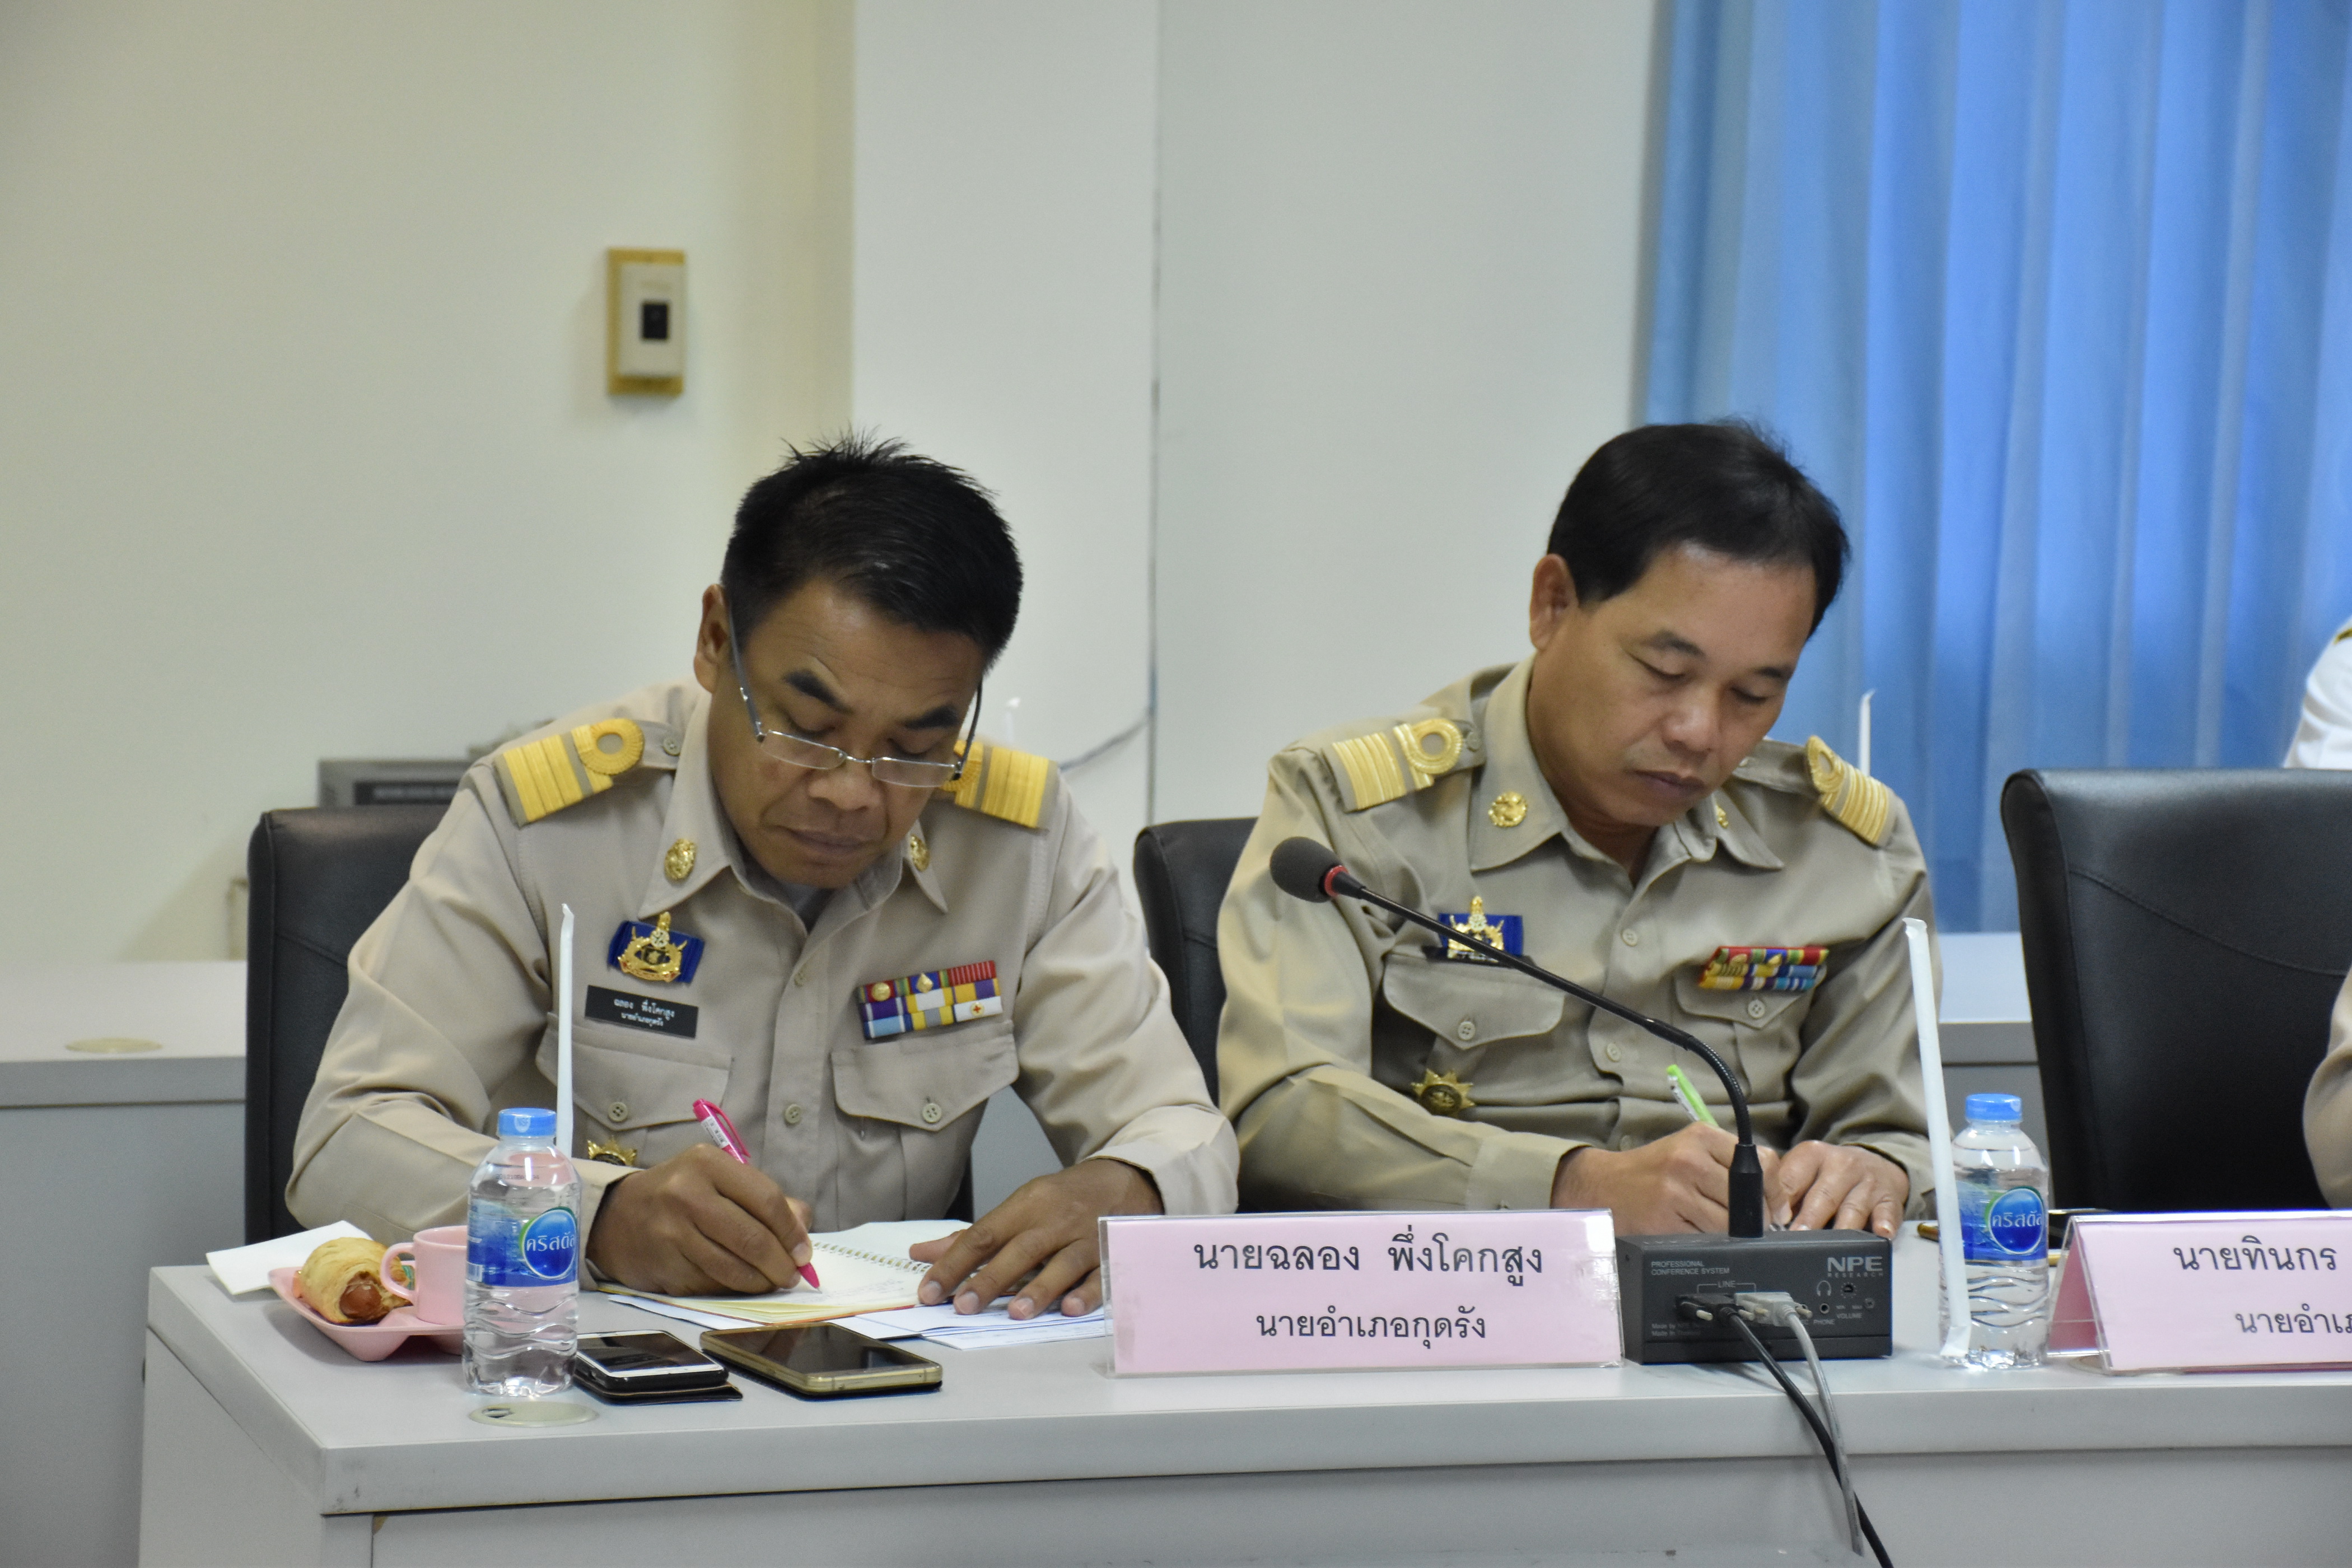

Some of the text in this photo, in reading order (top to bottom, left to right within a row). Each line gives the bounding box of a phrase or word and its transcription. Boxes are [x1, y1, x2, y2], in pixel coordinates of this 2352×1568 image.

[1193, 1224, 1543, 1287] นายฉลอง พึ่งโคกสูง
[1827, 1256, 1883, 1272] NPE
[2173, 1235, 2338, 1271] นายทินกร
[1256, 1305, 1487, 1350] นายอำเภอกุดรัง
